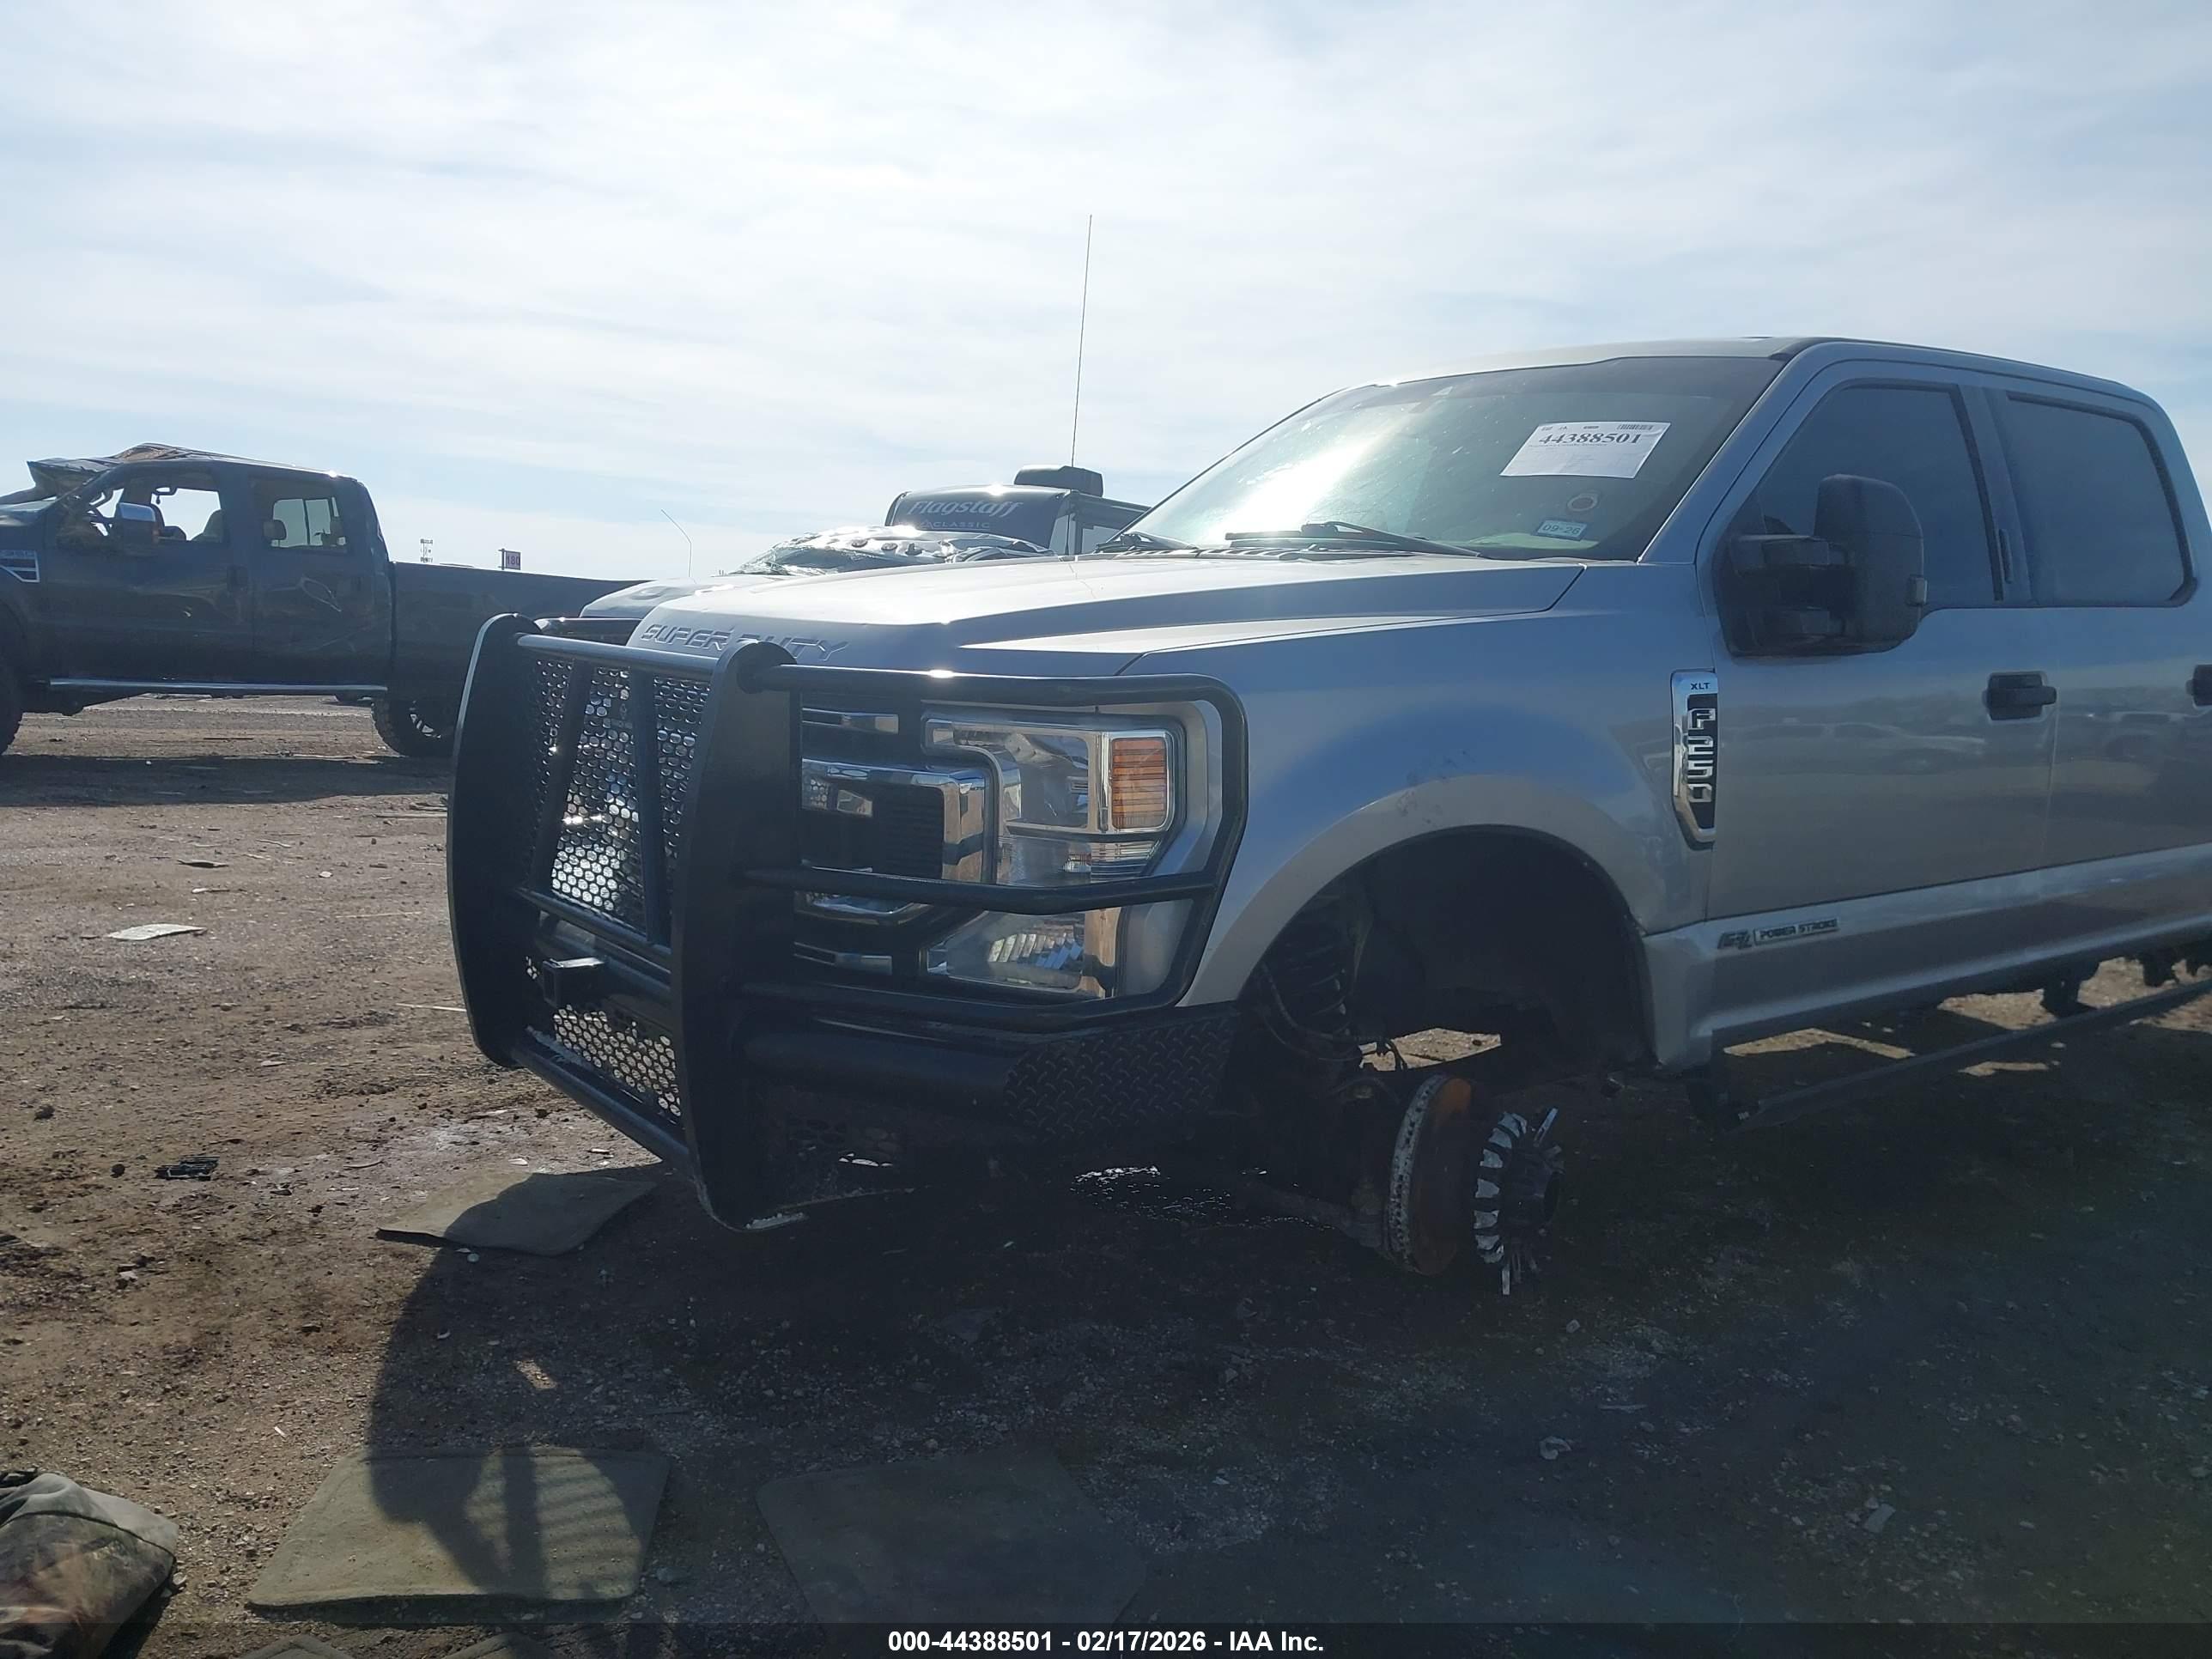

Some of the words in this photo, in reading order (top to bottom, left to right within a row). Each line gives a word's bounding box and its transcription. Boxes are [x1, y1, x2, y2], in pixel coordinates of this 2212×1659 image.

[1539, 433, 1641, 444] 44388501
[908, 501, 1024, 518] Flagstaff
[641, 624, 732, 651] SUPER
[1690, 682, 1711, 690] XLT
[1687, 708, 1716, 803] F250
